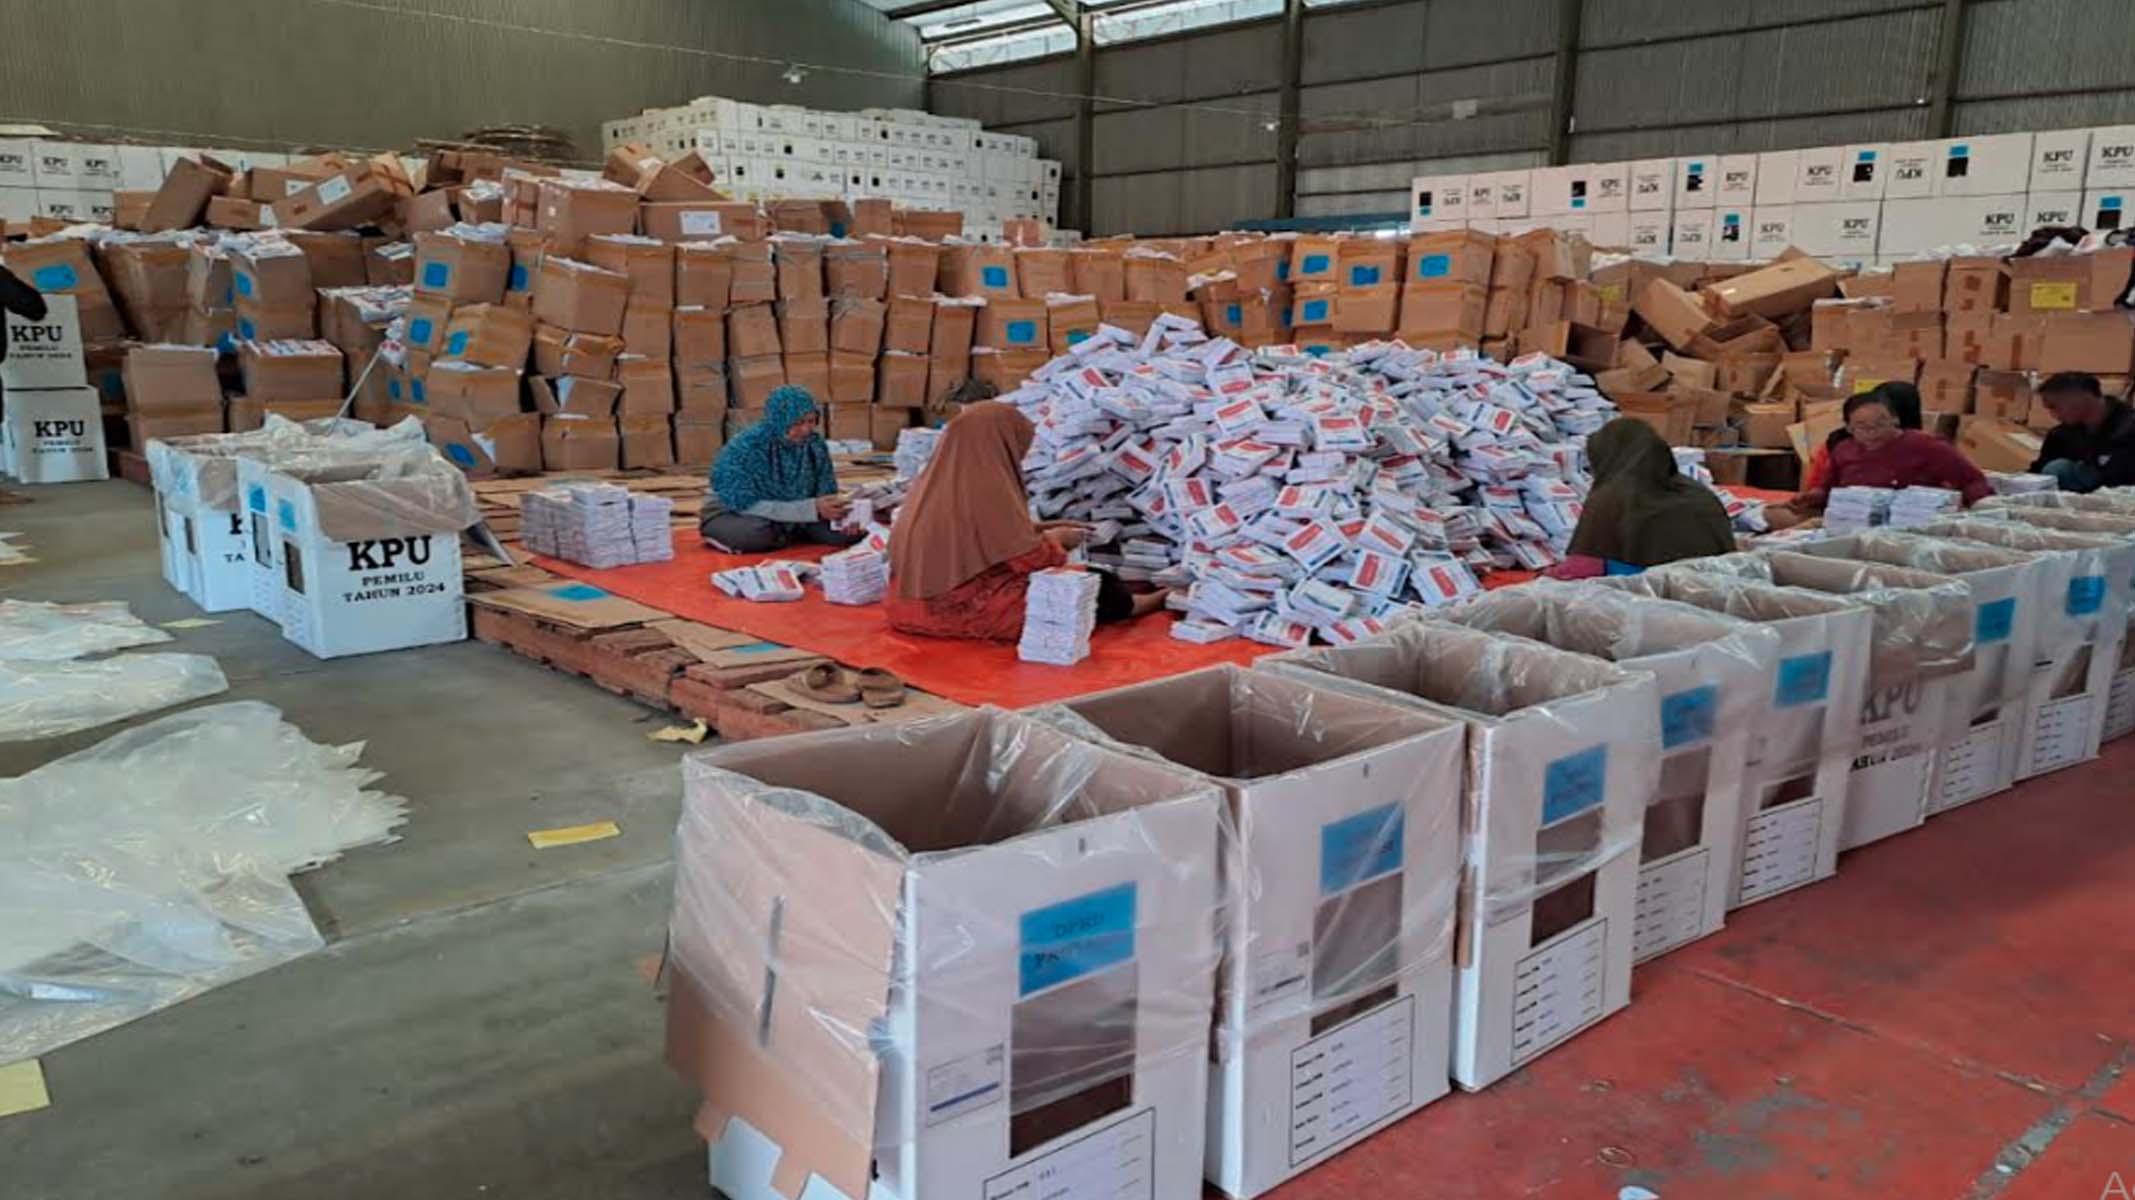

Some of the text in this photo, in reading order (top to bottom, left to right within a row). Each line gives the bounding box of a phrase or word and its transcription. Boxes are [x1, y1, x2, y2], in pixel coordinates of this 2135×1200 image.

[10, 325, 62, 343] KPU
[34, 420, 85, 438] KPU
[347, 534, 433, 571] KPU
[362, 571, 426, 587] PEMILU
[341, 582, 446, 603] TAHUN 2024
